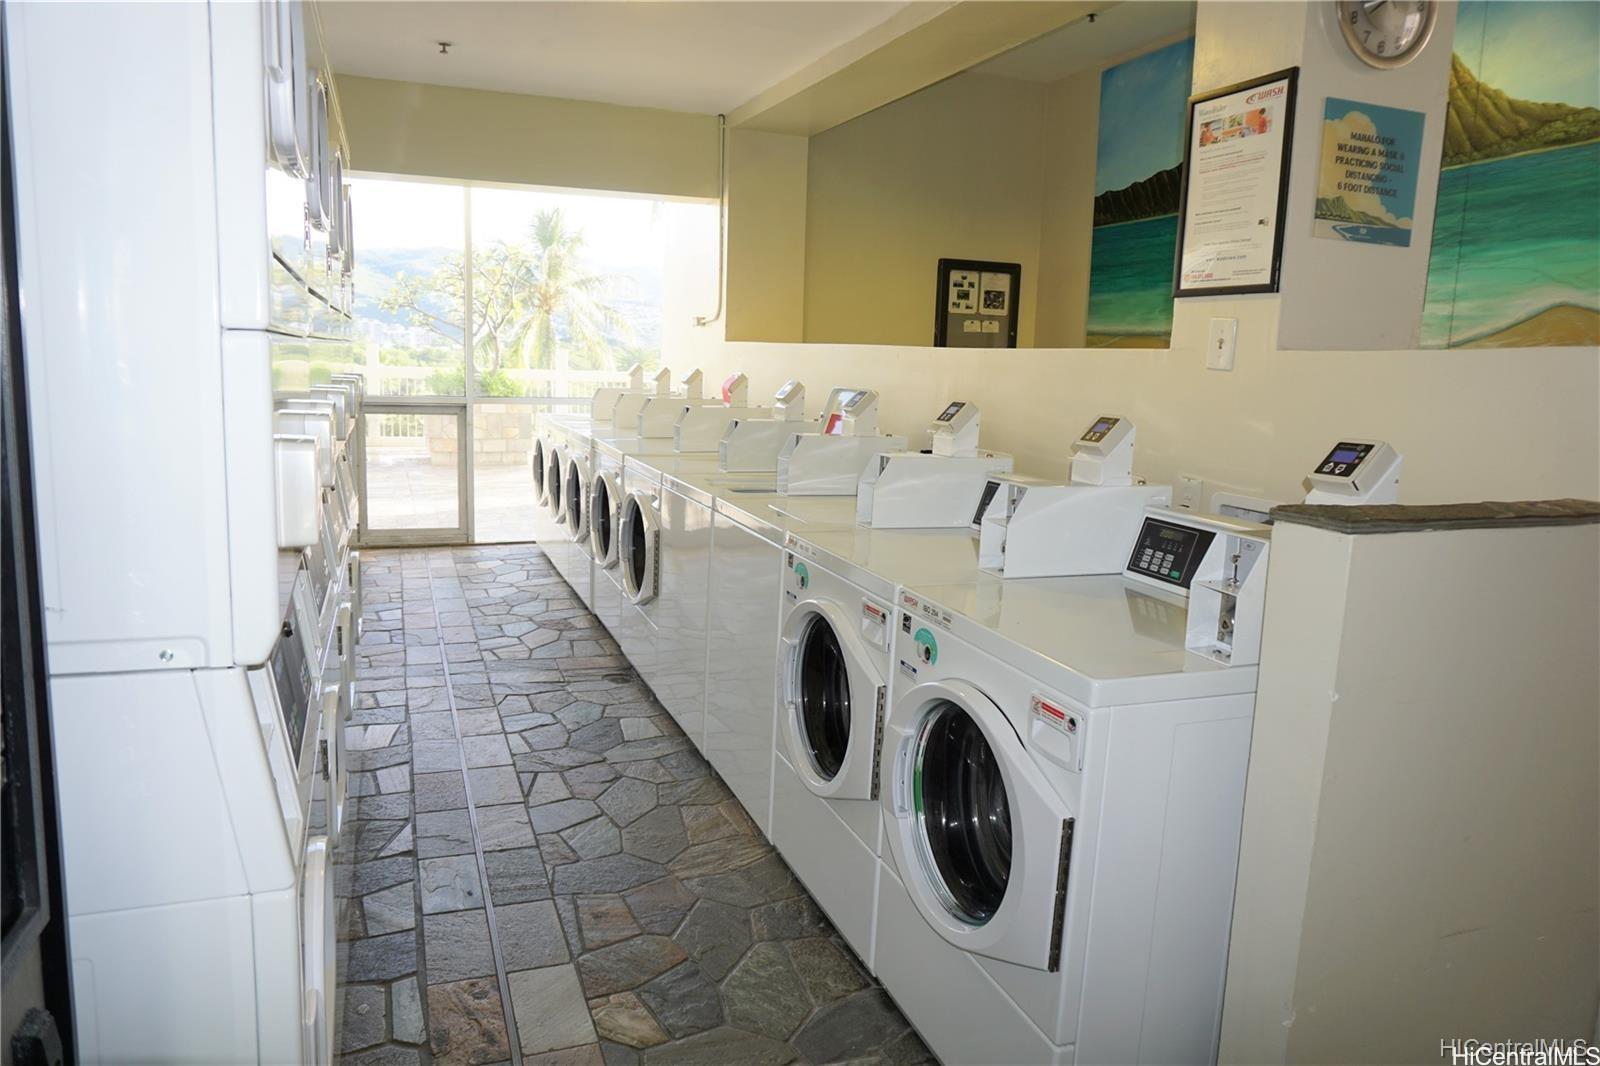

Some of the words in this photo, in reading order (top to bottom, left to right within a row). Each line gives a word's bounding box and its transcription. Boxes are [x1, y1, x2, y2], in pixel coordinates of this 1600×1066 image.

[1351, 11, 1358, 24] 8
[1363, 30, 1371, 43] 7
[1377, 40, 1385, 54] 6
[1258, 86, 1285, 100] WASH
[1350, 132, 1380, 144] MAHALO
[1381, 136, 1396, 146] FOR
[1337, 143, 1370, 155] WEARING
[1371, 148, 1377, 156] A
[1378, 149, 1398, 159] MASK
[1335, 155, 1378, 169] PRACTICING
[1379, 162, 1404, 173] SOCIAL
[1345, 170, 1388, 183] DISTANCING
[1337, 181, 1343, 190] 6
[1343, 182, 1362, 193] FOOT
[1364, 185, 1398, 198] DISTANCE
